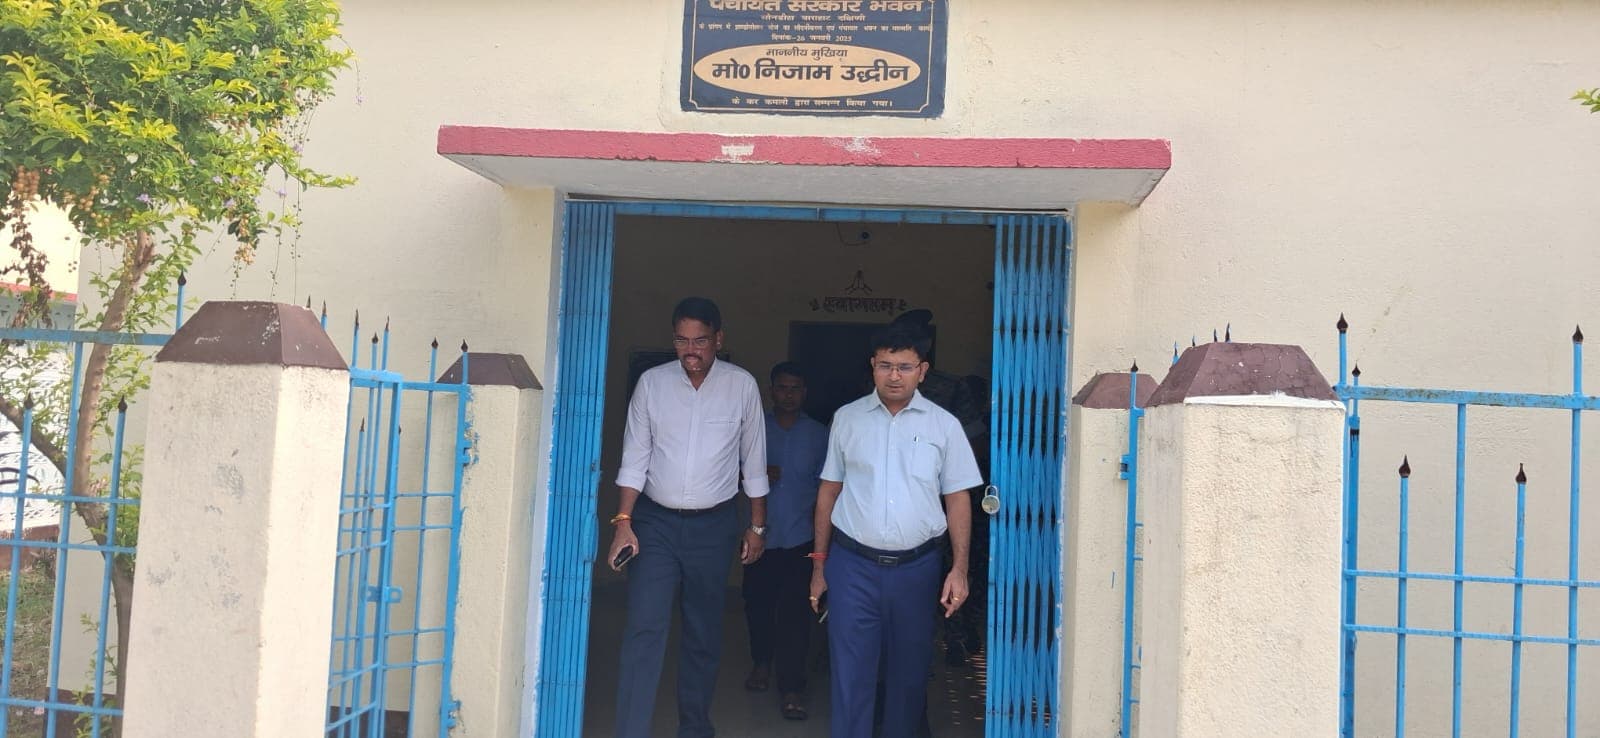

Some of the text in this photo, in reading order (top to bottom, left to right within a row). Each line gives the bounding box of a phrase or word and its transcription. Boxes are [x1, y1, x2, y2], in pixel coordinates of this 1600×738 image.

[709, 0, 924, 12] पचायत सरकार भवन
[766, 46, 848, 60] माननीय मुखिया
[754, 57, 833, 80] निजाम
[846, 98, 866, 107] किया
